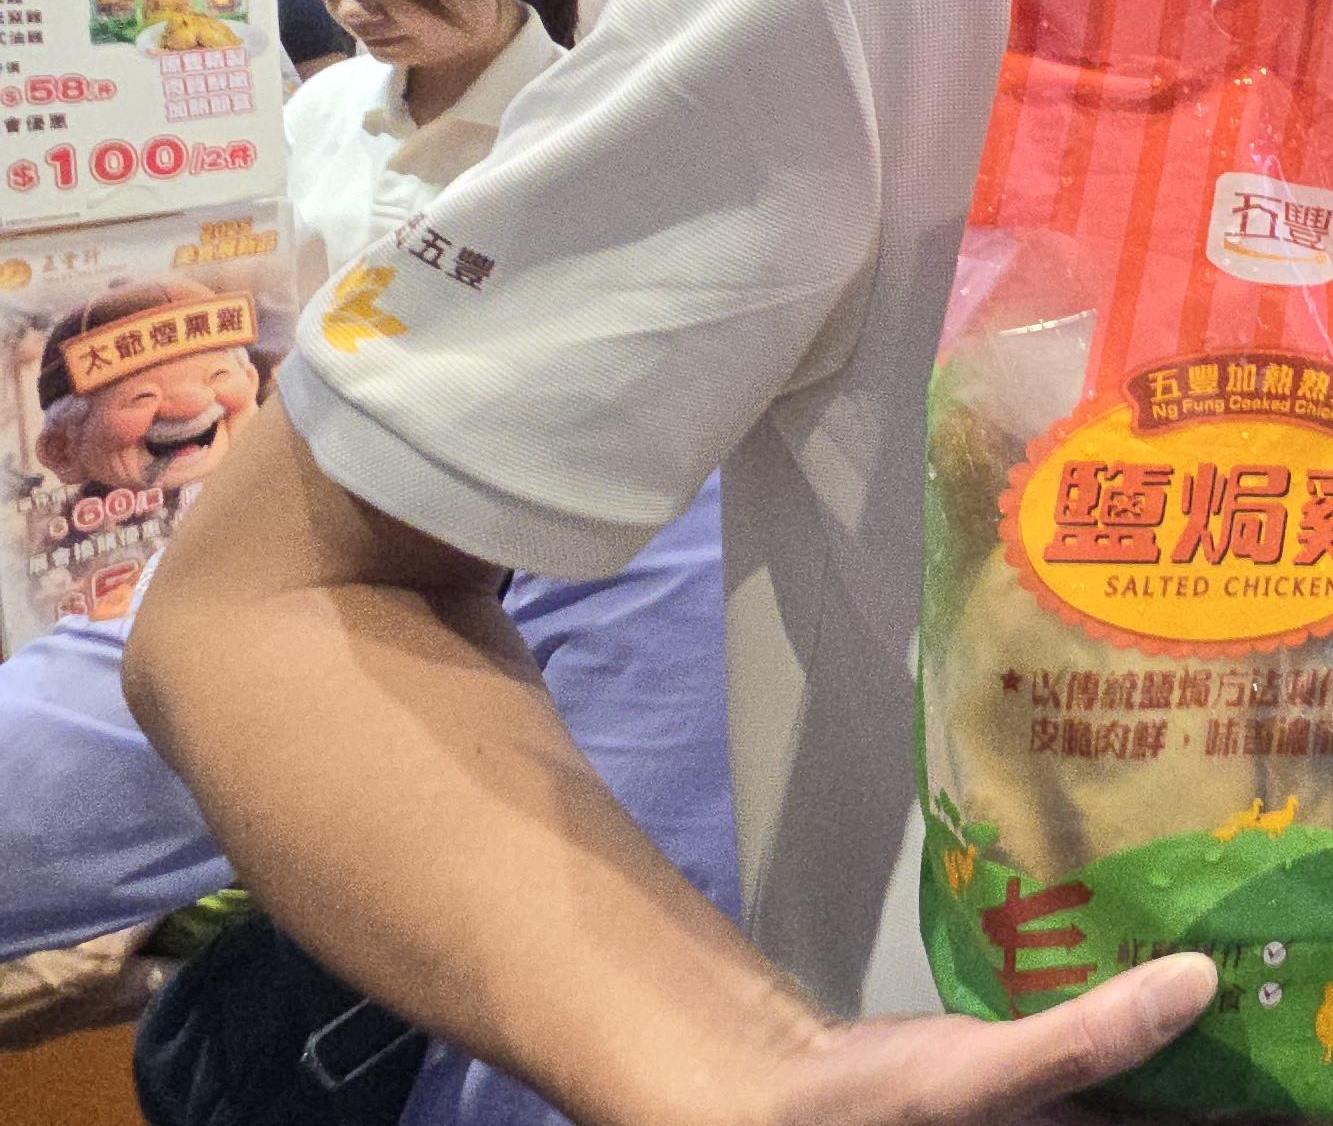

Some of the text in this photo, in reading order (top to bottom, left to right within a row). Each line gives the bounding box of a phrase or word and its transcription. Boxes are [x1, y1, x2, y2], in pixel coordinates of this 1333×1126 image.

[6, 133, 258, 192] $100/2件
[1152, 398, 1178, 422] Ng
[1181, 397, 1224, 419] Fung
[1229, 395, 1291, 414] Cooked
[1104, 576, 1209, 599] SALTED
